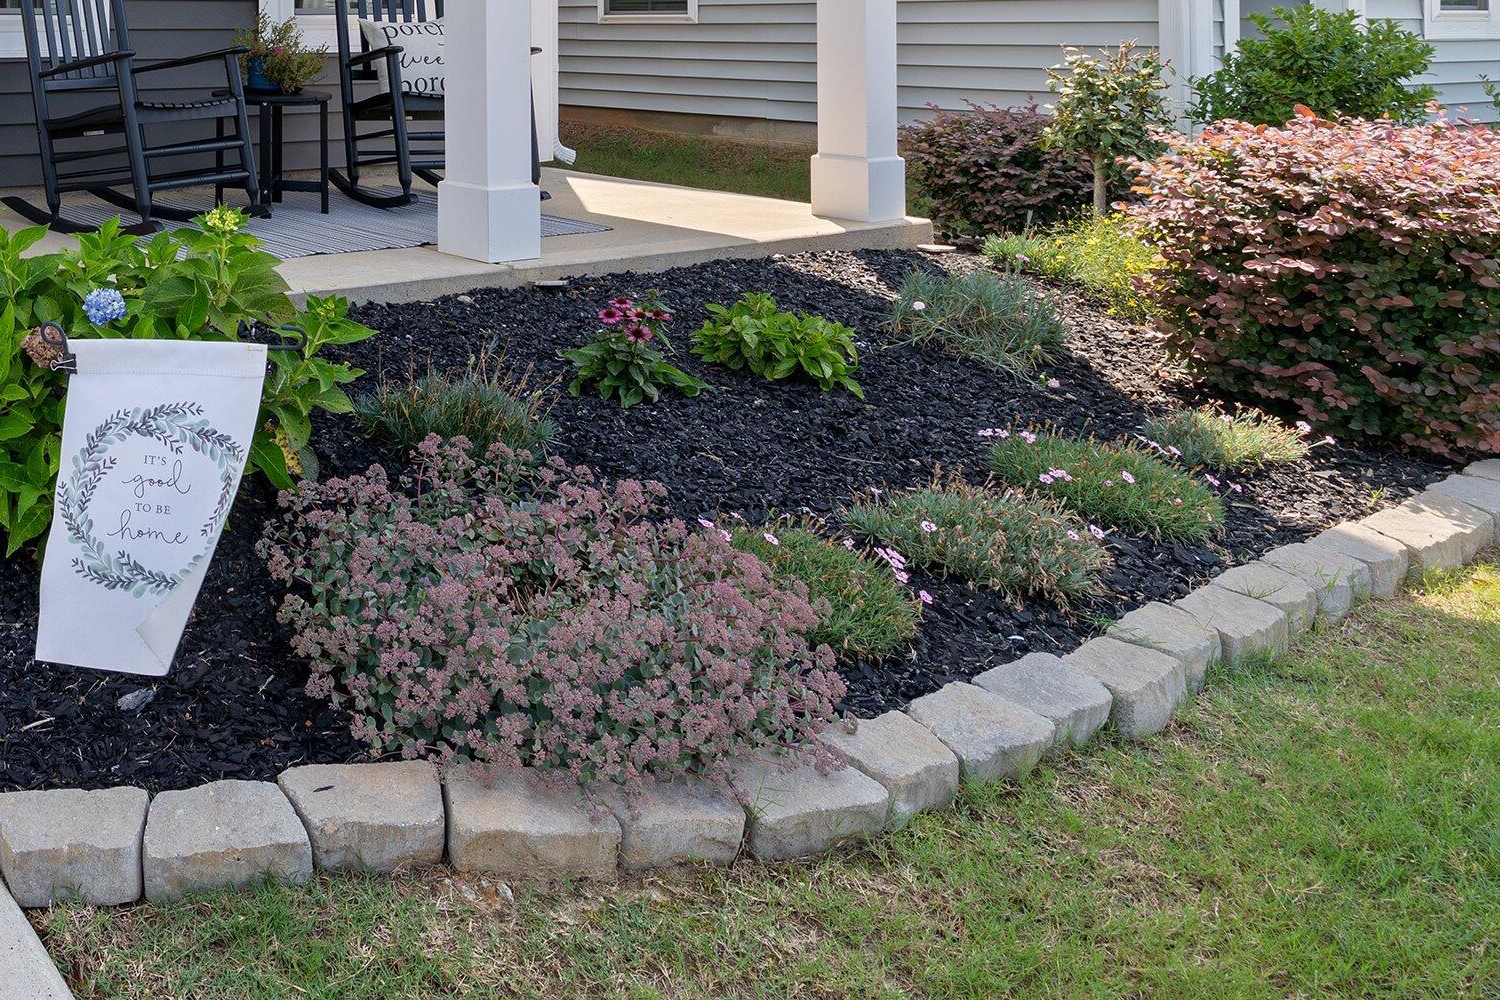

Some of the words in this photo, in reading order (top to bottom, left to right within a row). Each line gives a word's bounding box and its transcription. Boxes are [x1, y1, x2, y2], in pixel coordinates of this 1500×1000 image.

[143, 454, 168, 467] IT'S
[122, 459, 192, 498] good
[135, 502, 152, 514] TO
[156, 503, 171, 515] BE
[107, 509, 189, 544] home
